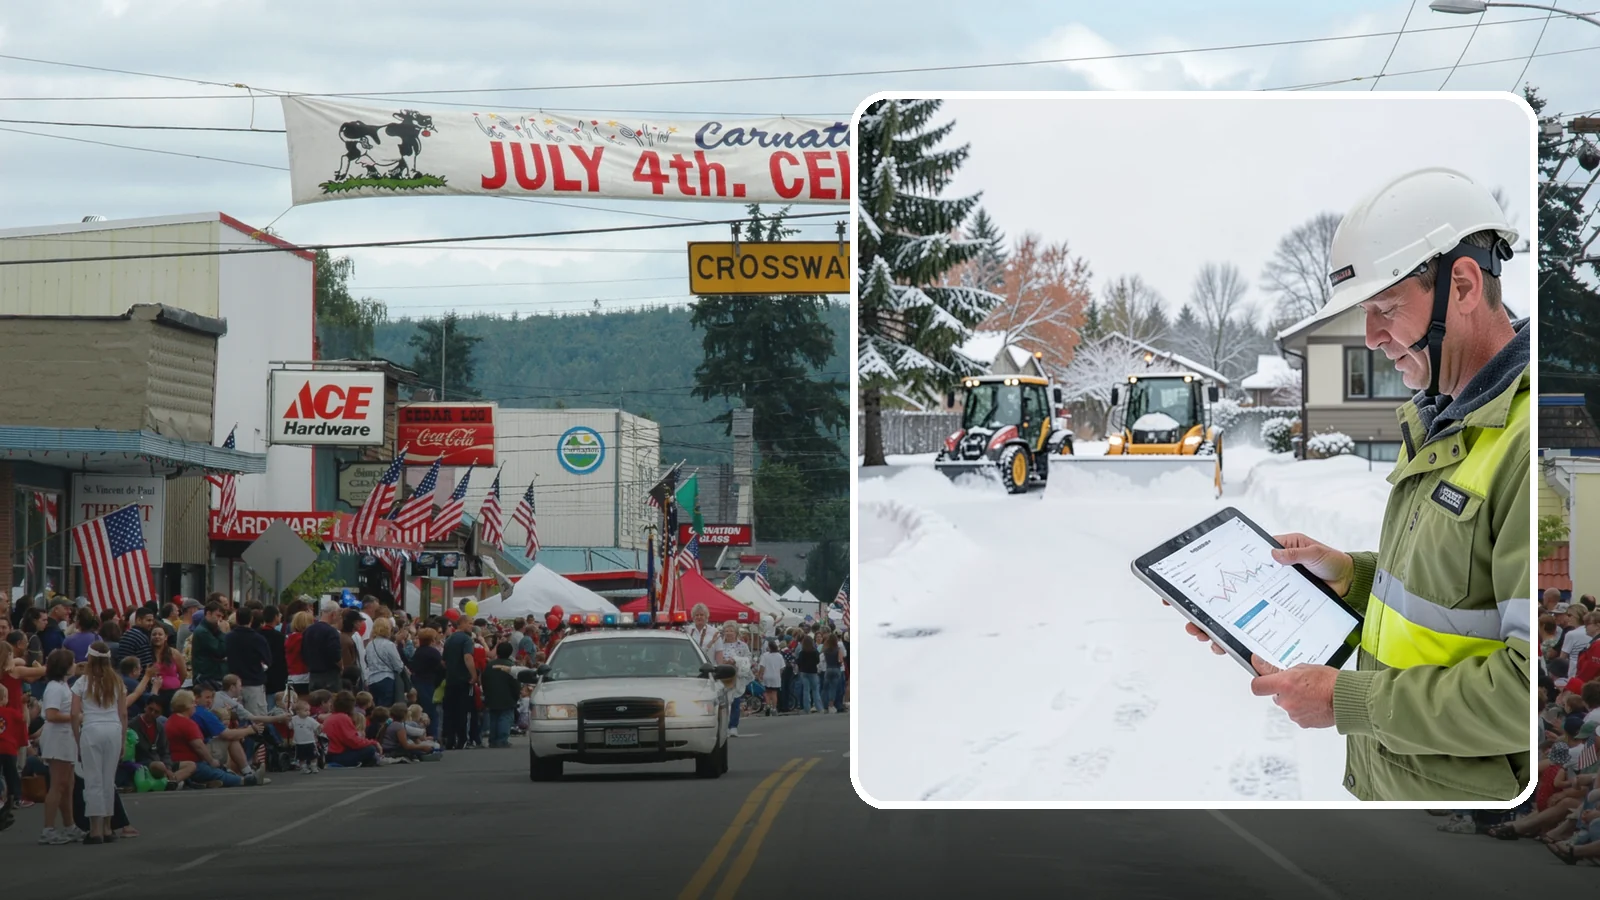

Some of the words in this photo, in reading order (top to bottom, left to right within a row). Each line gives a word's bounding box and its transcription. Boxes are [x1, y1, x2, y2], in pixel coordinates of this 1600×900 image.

[481, 141, 604, 193] JULY
[633, 150, 746, 198] 4th.
[696, 254, 850, 281] CROSSWA
[282, 380, 374, 420] ACE
[406, 409, 452, 421] CEDAR
[283, 420, 371, 436] Hardware
[416, 428, 477, 447] Coca-Cola
[95, 485, 124, 495] Vincent
[126, 486, 136, 495] de
[137, 486, 155, 495] Paul
[688, 526, 742, 535] CRNATION
[699, 535, 730, 544] GLASS
